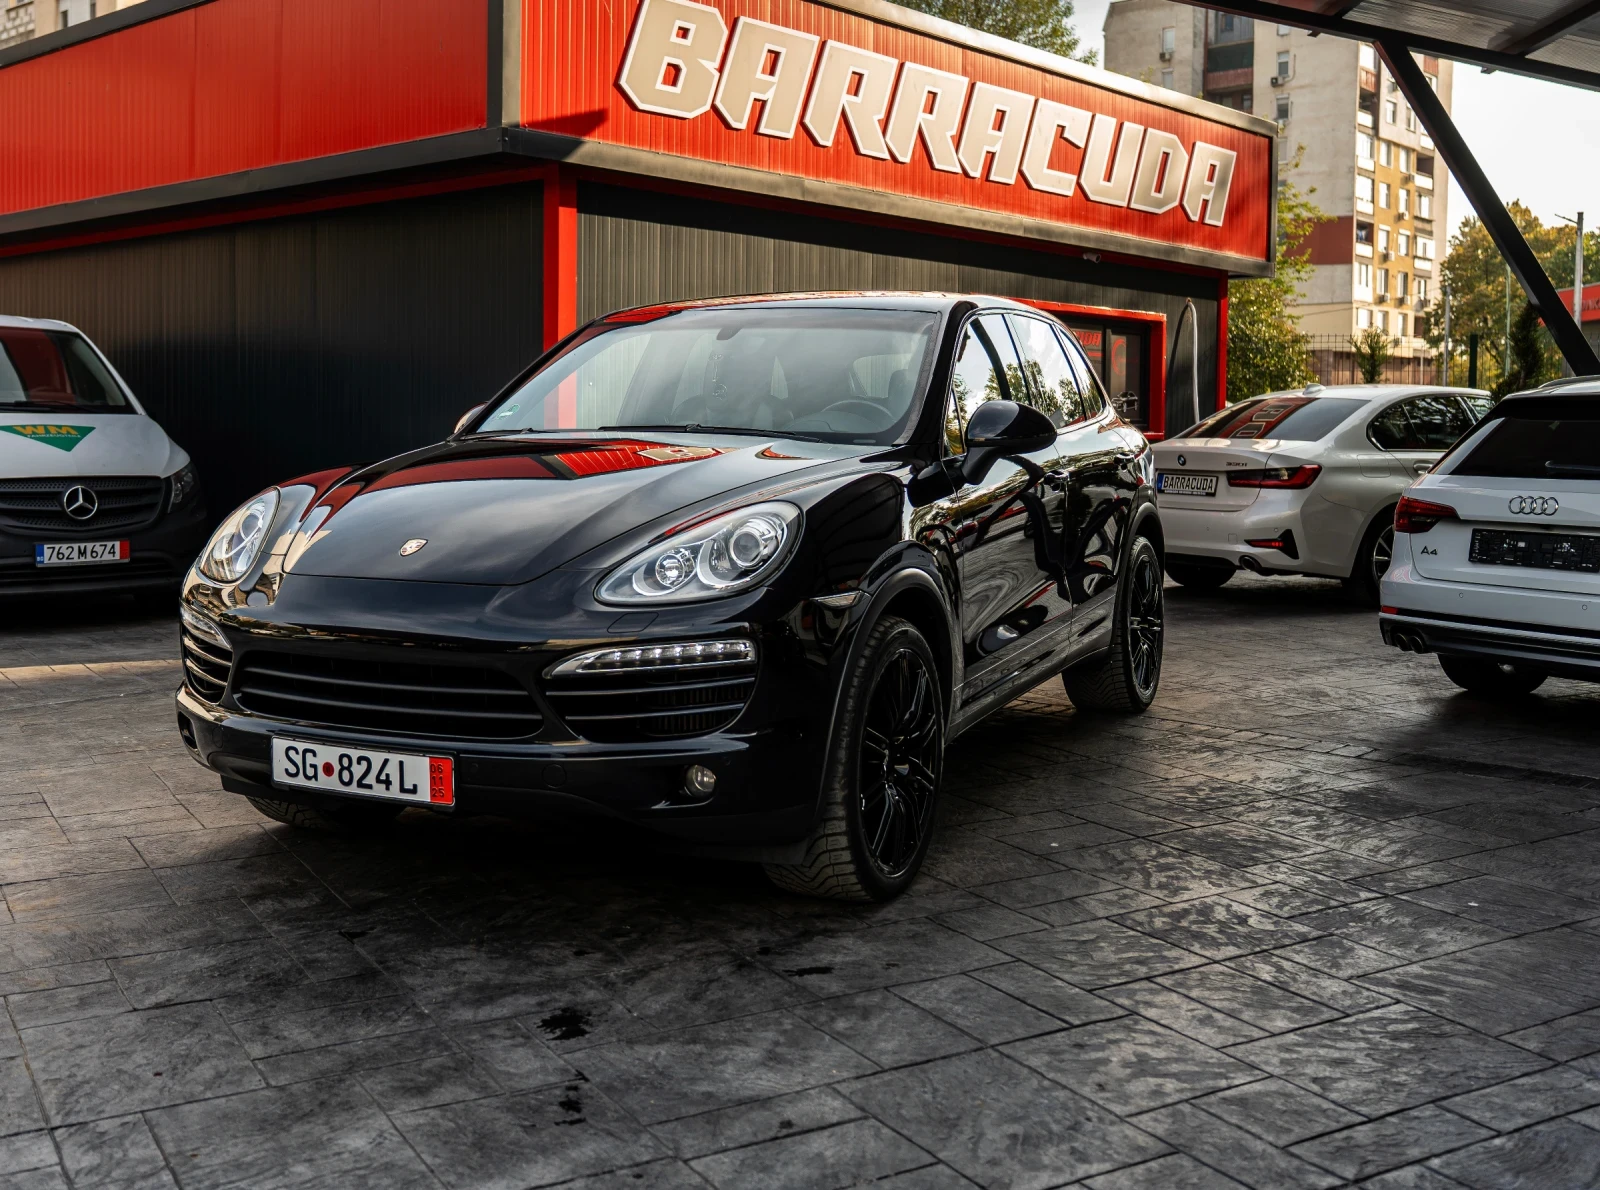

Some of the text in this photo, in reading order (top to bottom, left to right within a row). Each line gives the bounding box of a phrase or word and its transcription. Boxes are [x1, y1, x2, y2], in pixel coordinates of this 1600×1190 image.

[618, 0, 1237, 226] BARRACUDA
[13, 425, 79, 434] WM
[1163, 476, 1213, 491] BARRACUDA
[47, 546, 75, 562] 762
[78, 545, 87, 559] M
[91, 544, 116, 558] 674
[1420, 545, 1438, 556] A4
[285, 746, 418, 795] SG 824L
[430, 763, 443, 773] 06
[431, 775, 443, 786] 11
[431, 787, 445, 798] 25
